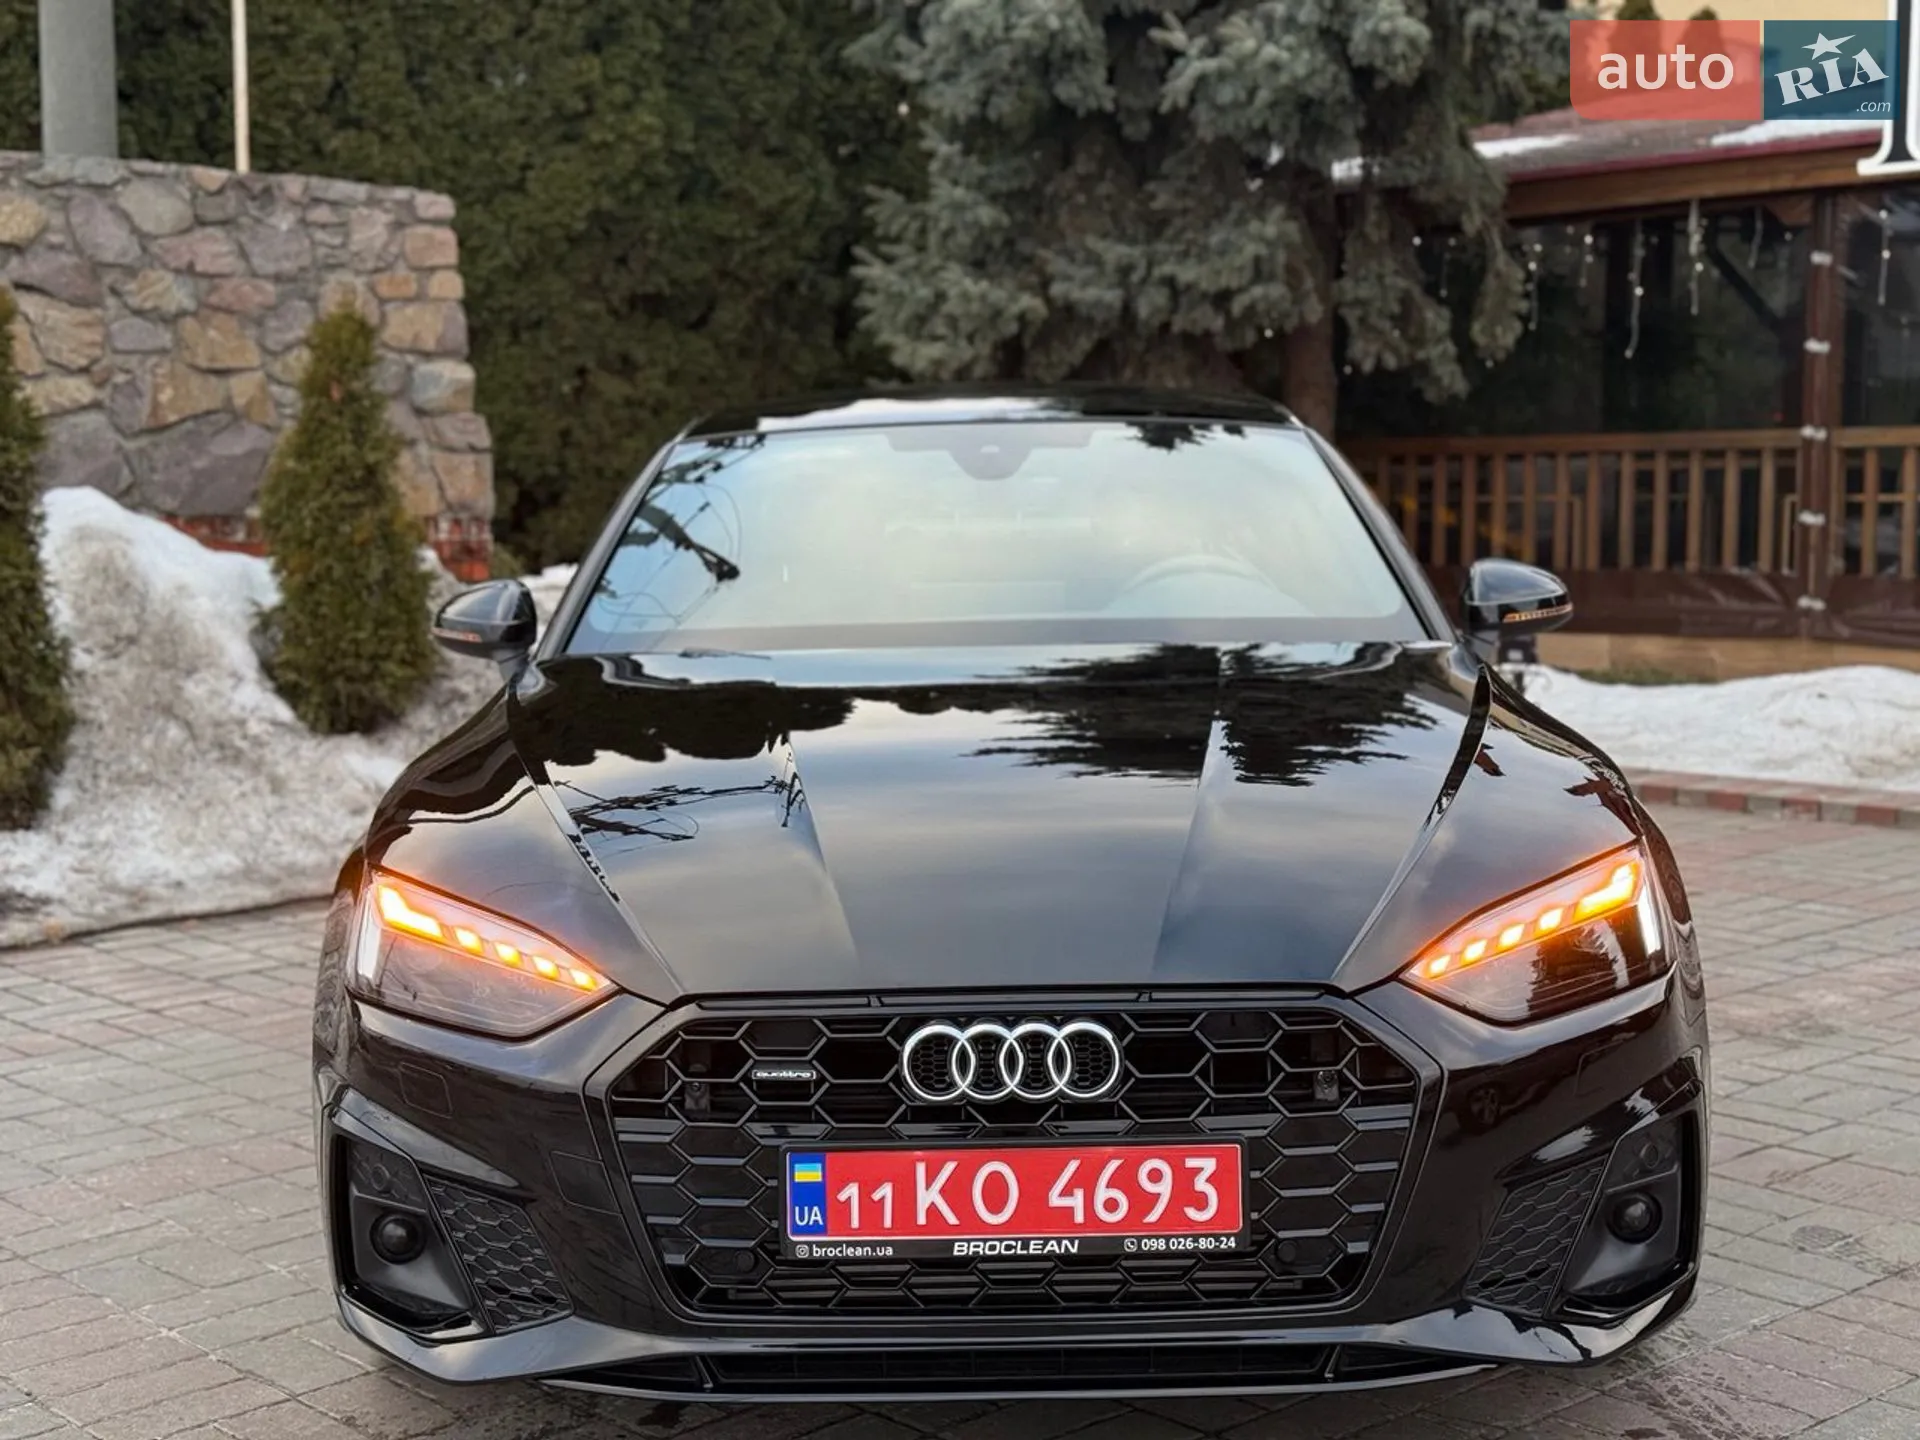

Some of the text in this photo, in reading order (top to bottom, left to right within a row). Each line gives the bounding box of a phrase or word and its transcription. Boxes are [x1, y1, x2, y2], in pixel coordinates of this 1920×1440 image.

[837, 1182, 893, 1229] 11
[1048, 1157, 1219, 1224] 4693
[794, 1205, 823, 1226] UA
[812, 1243, 894, 1257] broclean.ua
[952, 1239, 1079, 1256] BROCLEAN
[1141, 1237, 1236, 1250] 098 026-80-24
